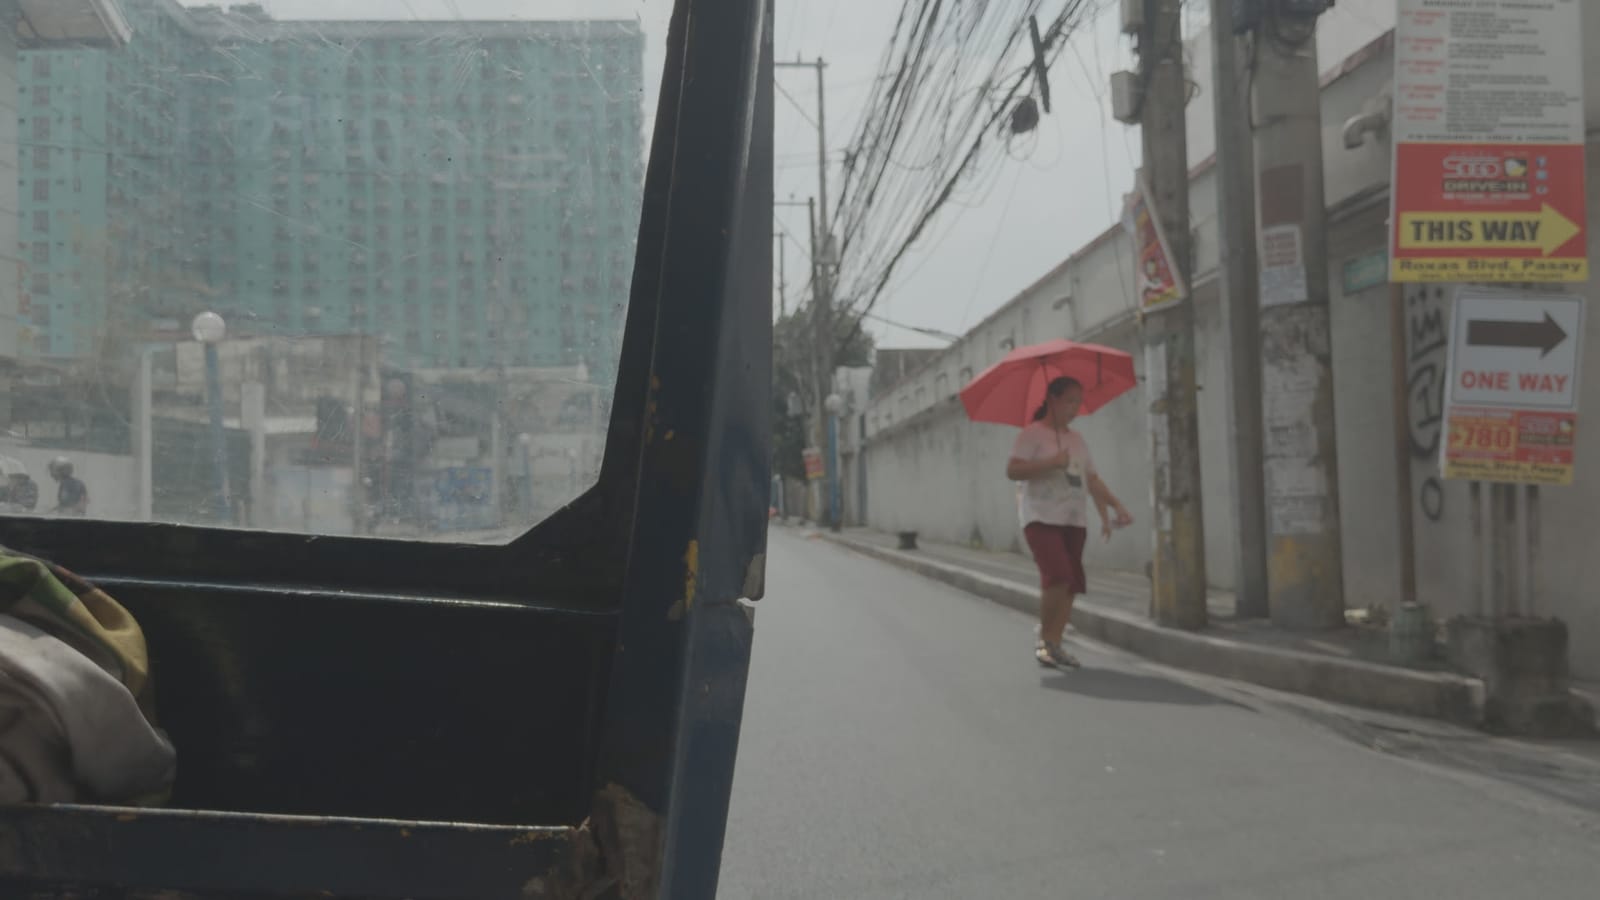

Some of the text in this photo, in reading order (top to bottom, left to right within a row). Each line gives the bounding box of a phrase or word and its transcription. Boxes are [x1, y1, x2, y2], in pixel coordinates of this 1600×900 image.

[1410, 220, 1541, 241] THIS WAY
[1400, 259, 1459, 271] Roxas
[1522, 260, 1581, 273] Pasay
[1460, 370, 1569, 393] ONE WAY
